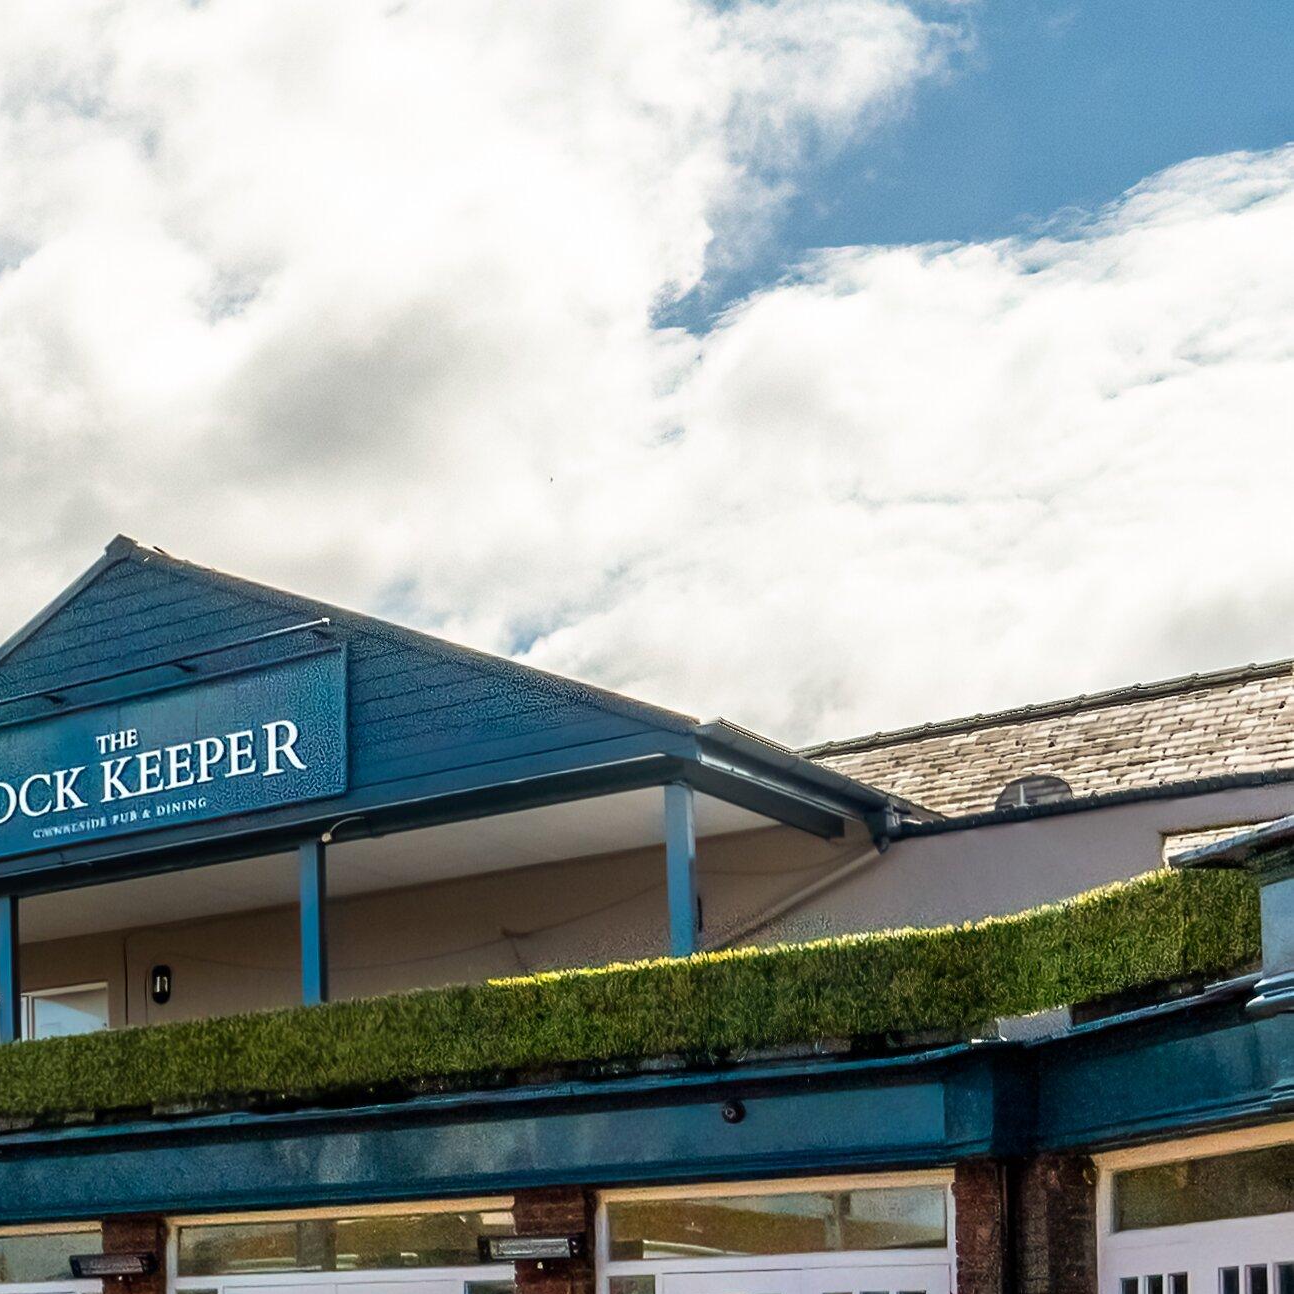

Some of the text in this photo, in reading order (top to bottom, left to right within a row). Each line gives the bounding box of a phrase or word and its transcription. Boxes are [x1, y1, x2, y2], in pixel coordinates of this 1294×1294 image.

[95, 729, 138, 755] THE
[99, 719, 307, 804] KEEPER
[111, 810, 138, 826] PUB
[141, 808, 151, 820] &
[156, 797, 208, 817] DINING
